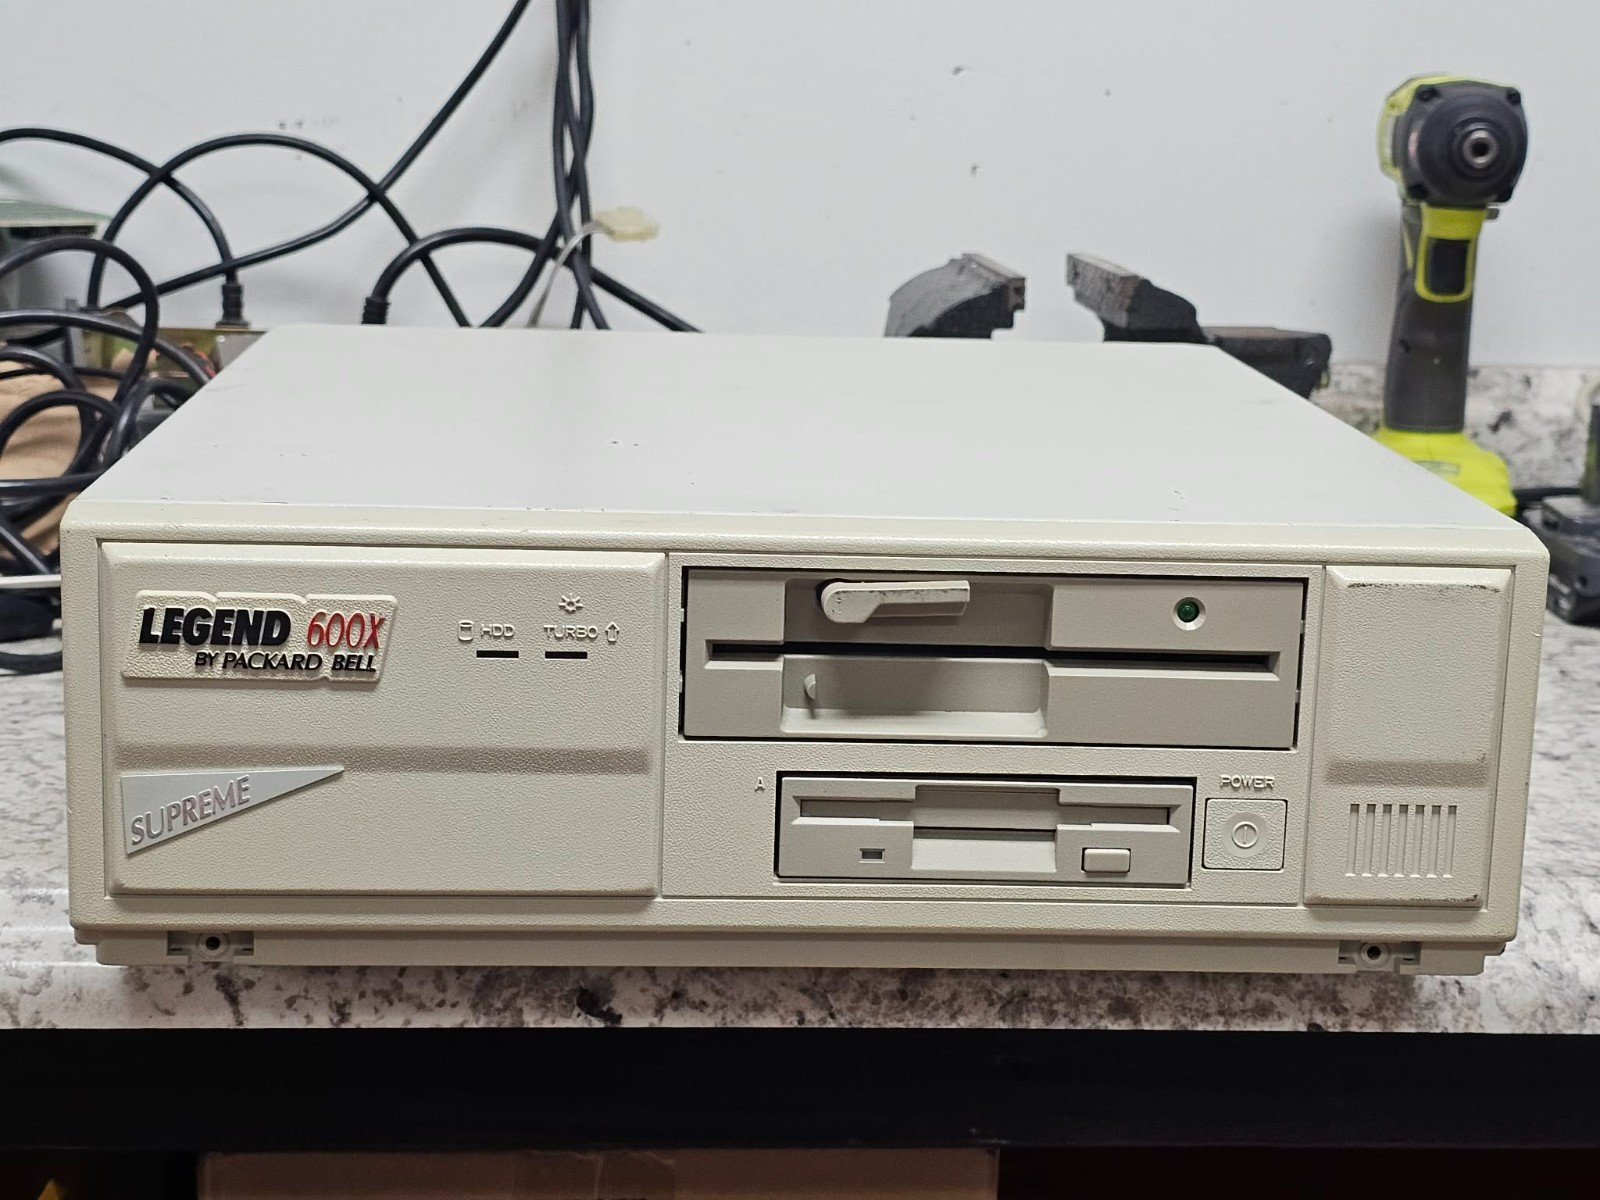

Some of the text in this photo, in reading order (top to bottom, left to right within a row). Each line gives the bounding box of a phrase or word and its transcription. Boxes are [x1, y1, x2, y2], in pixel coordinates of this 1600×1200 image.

[139, 607, 385, 649] LEGEND 600X
[481, 623, 515, 638] HDD
[543, 624, 598, 639] TURBO
[195, 651, 377, 672] BY PACKARD BELL
[754, 777, 765, 791] A
[1220, 774, 1275, 789] POWER
[131, 774, 250, 846] SUPREME
